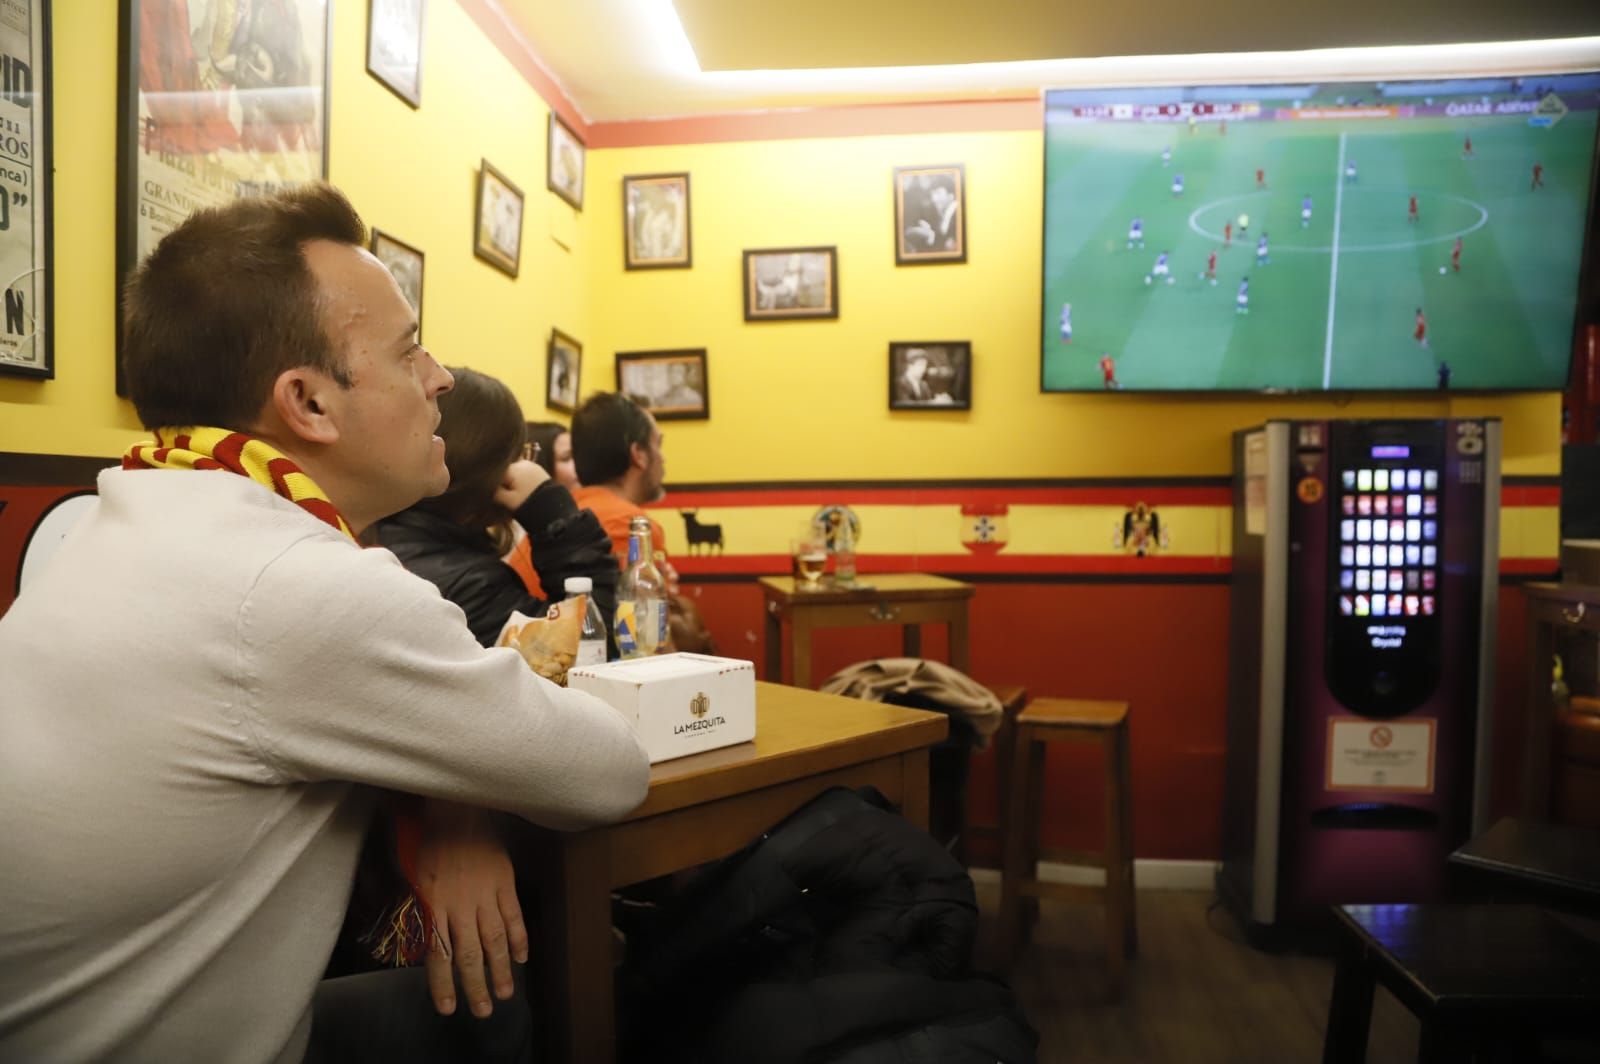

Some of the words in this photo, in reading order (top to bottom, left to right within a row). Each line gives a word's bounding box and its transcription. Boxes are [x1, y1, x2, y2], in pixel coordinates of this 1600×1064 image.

[0, 53, 32, 109] ID
[674, 725, 685, 735] LA
[685, 716, 726, 733] MEZQUITA
